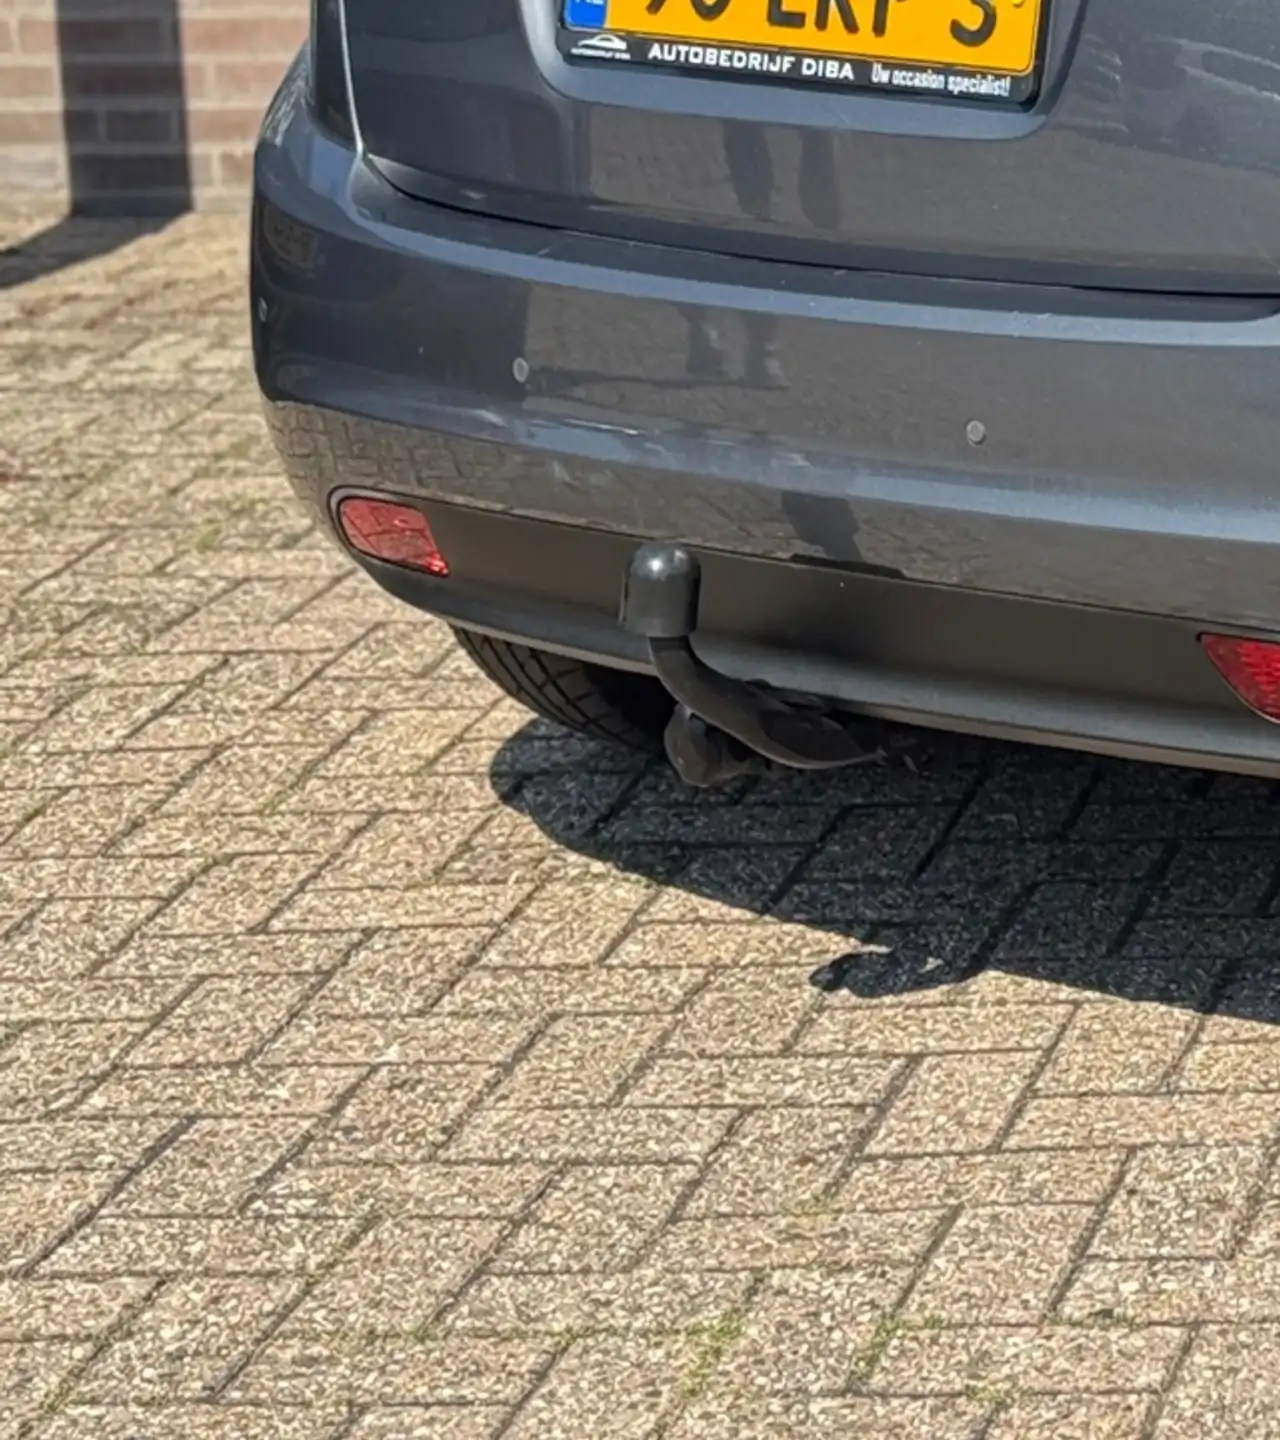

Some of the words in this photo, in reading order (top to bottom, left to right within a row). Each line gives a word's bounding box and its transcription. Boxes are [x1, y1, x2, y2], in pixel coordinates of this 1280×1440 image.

[647, 42, 796, 73] AUTOBEDRIJF
[801, 58, 855, 81] DIBA
[871, 62, 891, 84] Uw
[891, 68, 946, 90] occasion
